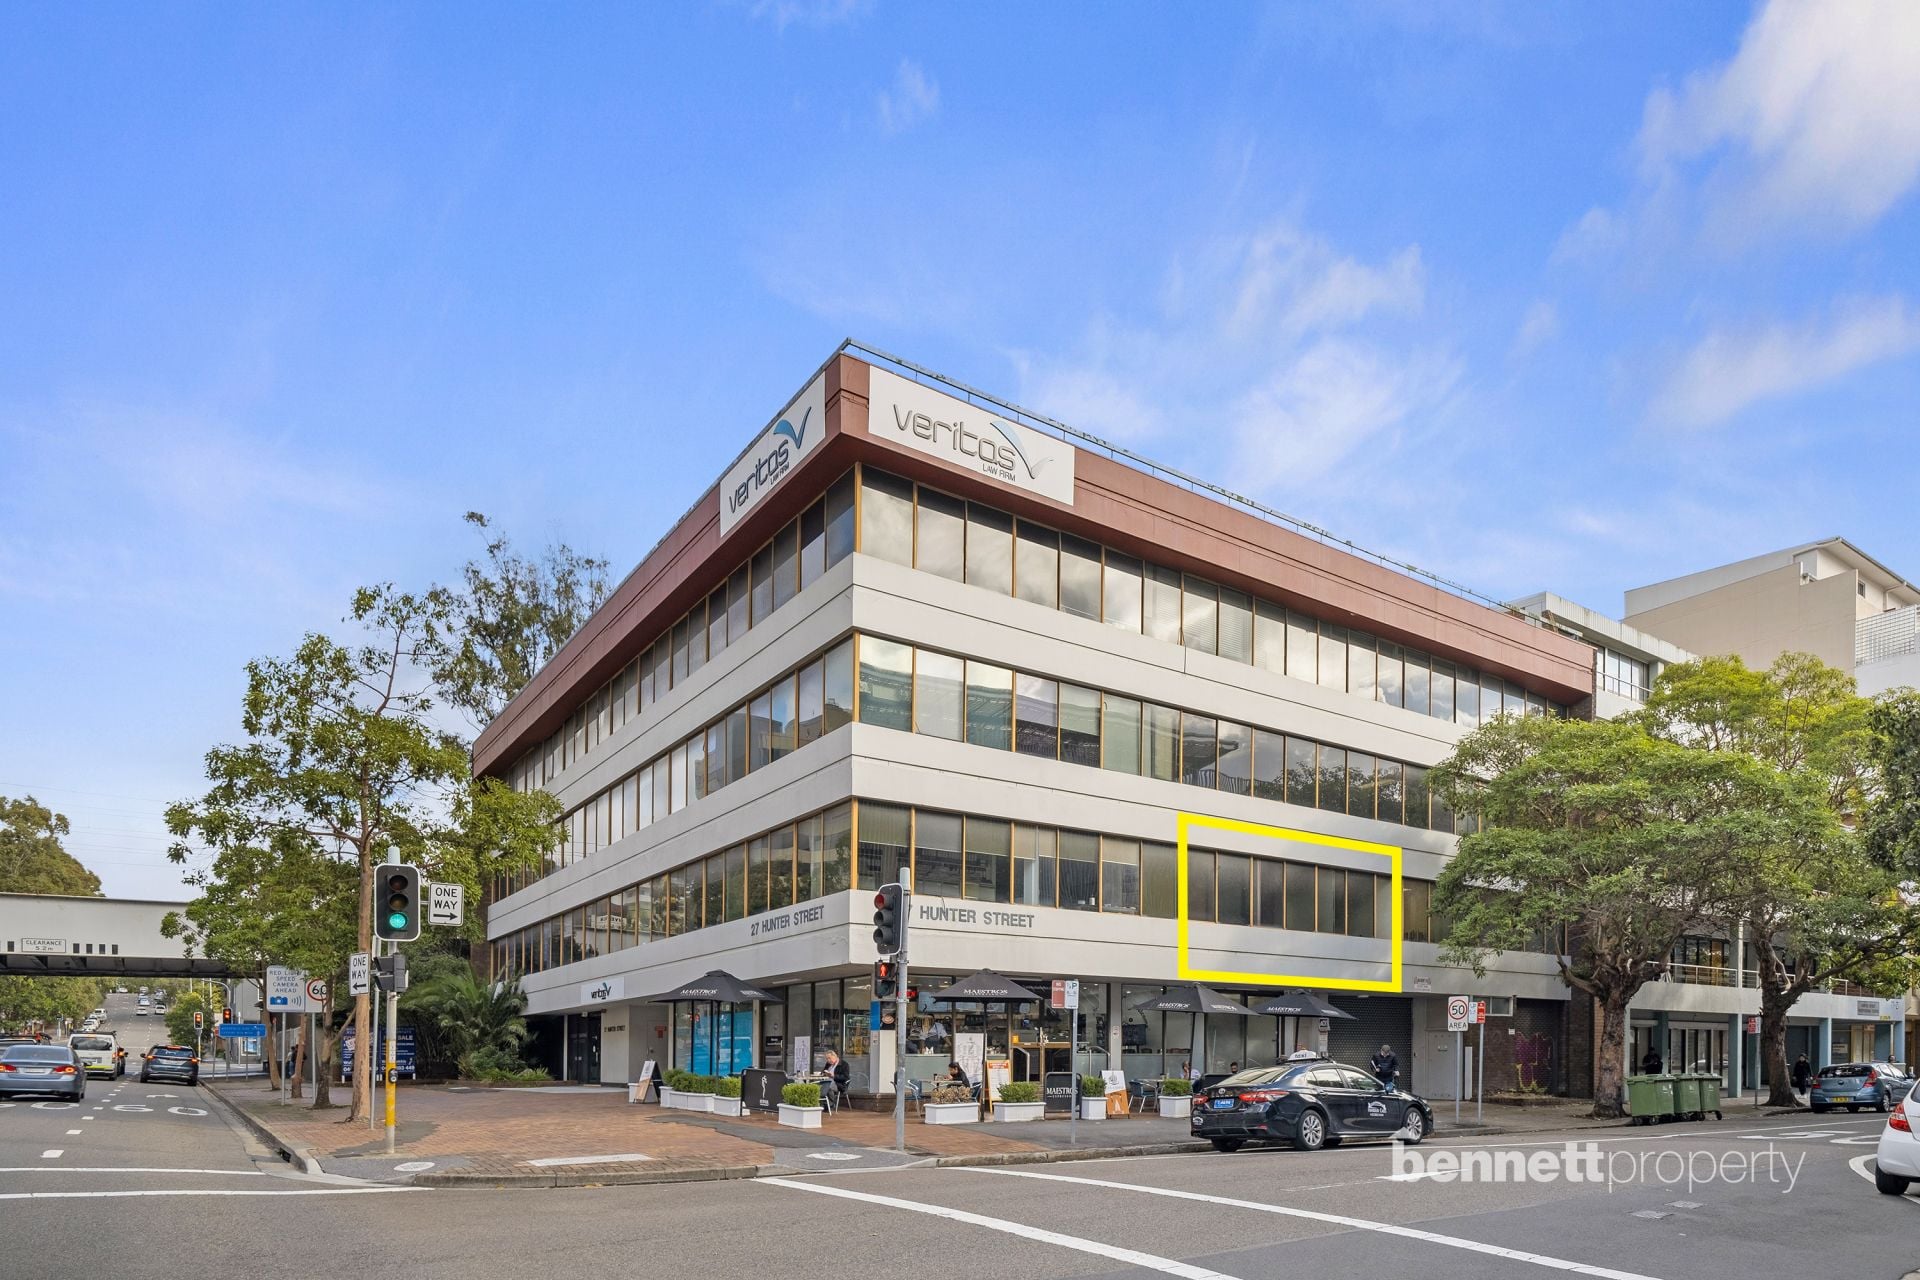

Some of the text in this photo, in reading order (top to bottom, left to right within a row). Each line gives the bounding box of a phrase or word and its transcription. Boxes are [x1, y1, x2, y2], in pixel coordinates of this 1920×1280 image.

[893, 404, 1016, 471] veritas
[729, 439, 789, 514] veritas
[982, 464, 1016, 482] LAW FIRM
[435, 887, 458, 897] ONE
[434, 900, 458, 910] WAY
[751, 905, 825, 936] 27 HUNTER STREET
[920, 905, 1035, 928] HUNTER STREET
[352, 957, 367, 967] ONE
[351, 970, 367, 980] WAY
[1452, 1005, 1465, 1015] 50
